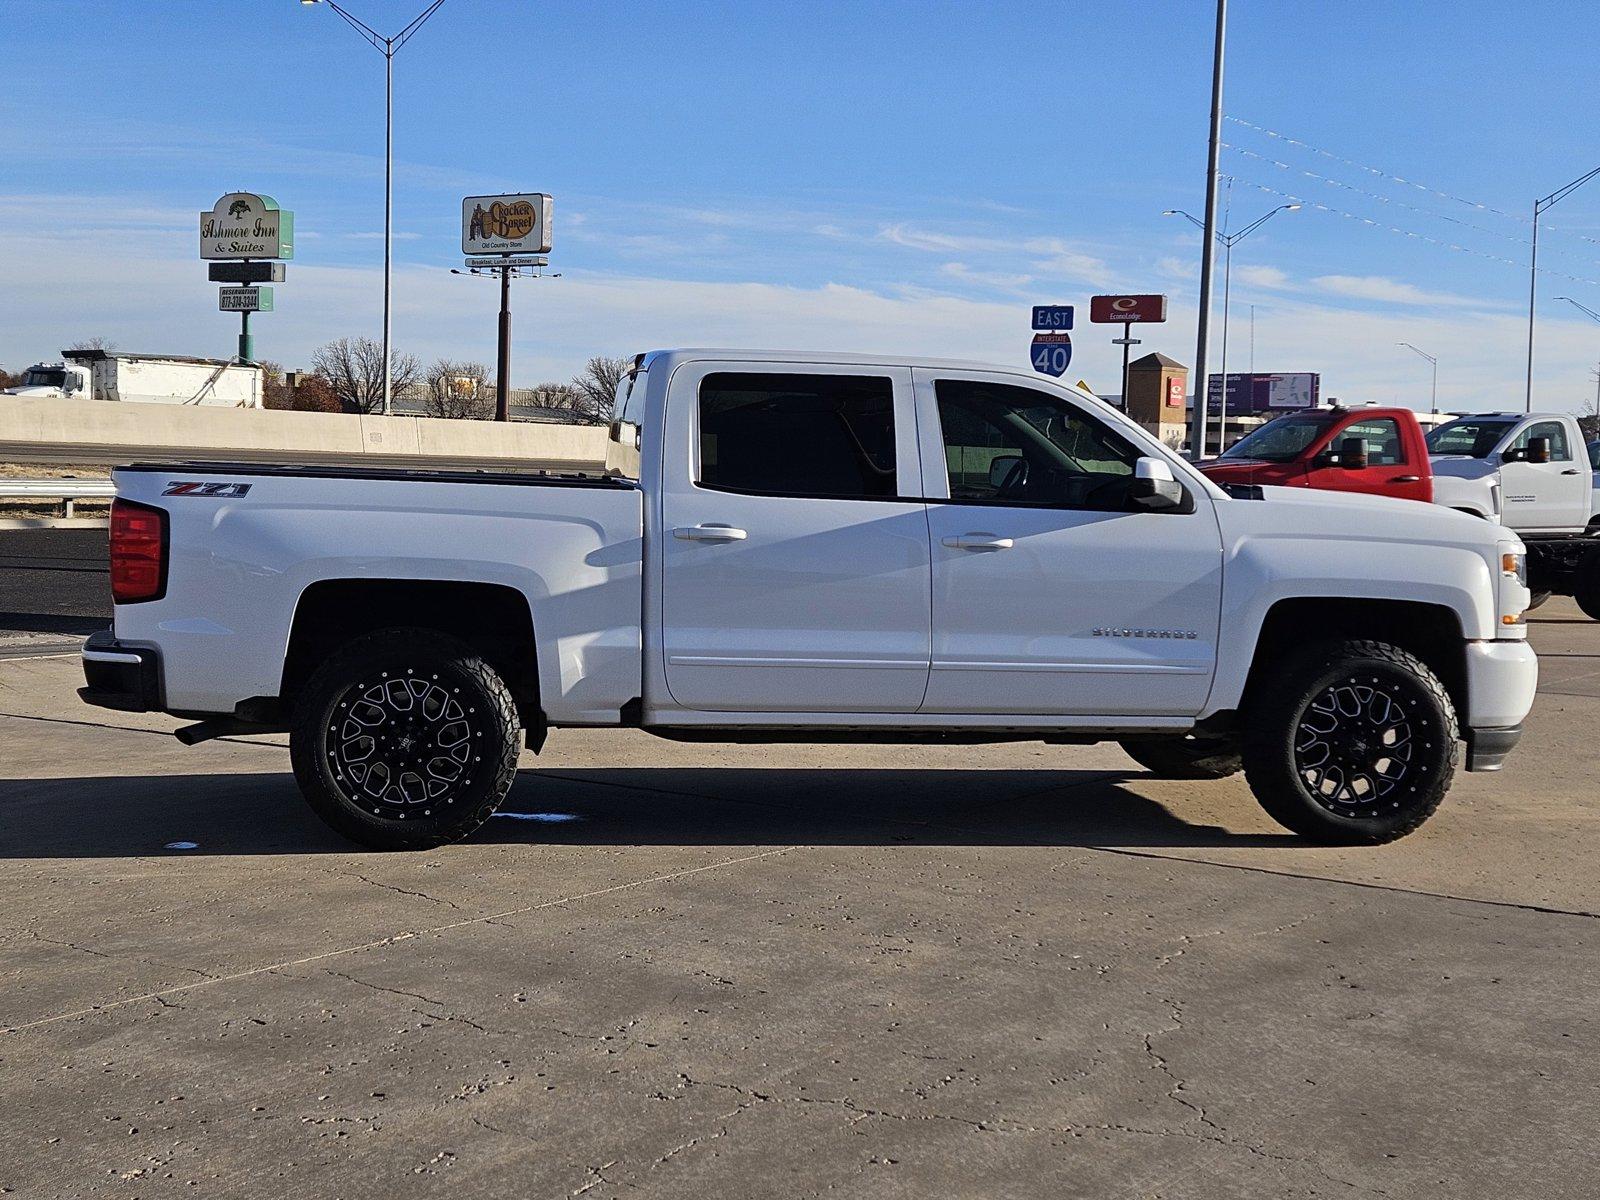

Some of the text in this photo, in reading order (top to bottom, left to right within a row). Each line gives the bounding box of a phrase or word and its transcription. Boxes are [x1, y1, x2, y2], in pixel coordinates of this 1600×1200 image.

[202, 218, 276, 238] Ashmore Inn
[214, 241, 265, 253] & Suites
[491, 242, 509, 250] Country
[1037, 310, 1068, 326] EAST
[1034, 348, 1067, 372] 40
[160, 481, 253, 498] Z71
[1092, 627, 1198, 640] SILVERADO
